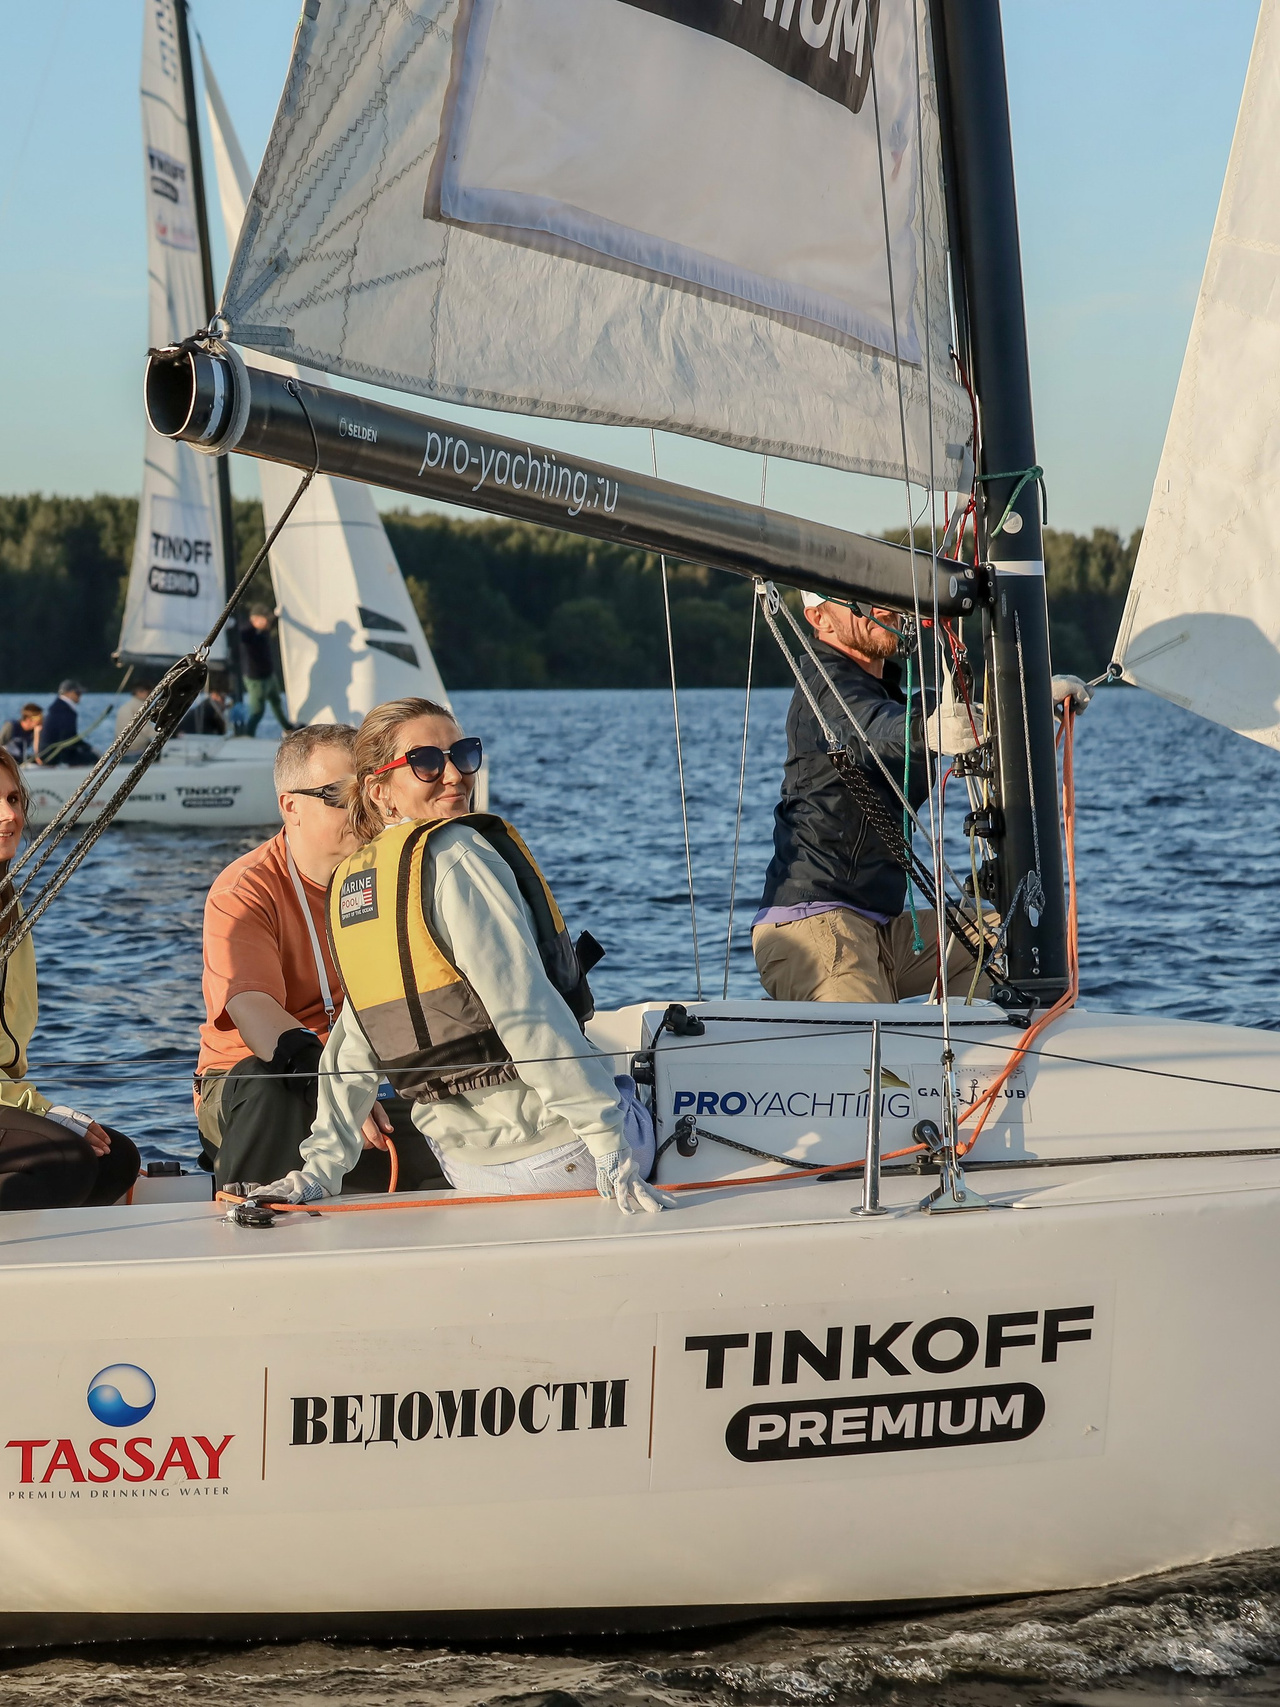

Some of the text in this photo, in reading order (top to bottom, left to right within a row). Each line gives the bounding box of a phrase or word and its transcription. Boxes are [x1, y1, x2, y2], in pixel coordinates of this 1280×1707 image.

[347, 423, 378, 443] SELDÉN
[418, 431, 619, 517] pro-yachting.ru
[151, 531, 213, 565] TINOFF
[341, 876, 372, 897] MARINE
[684, 1305, 1095, 1390] TINKOFF
[289, 1379, 629, 1450] ВЕДОМОСТИ
[746, 1394, 1025, 1451] PREMIUM
[4, 1435, 236, 1483] TASSAY
[8, 1486, 230, 1500] PREMIUM DRINKING WATER
